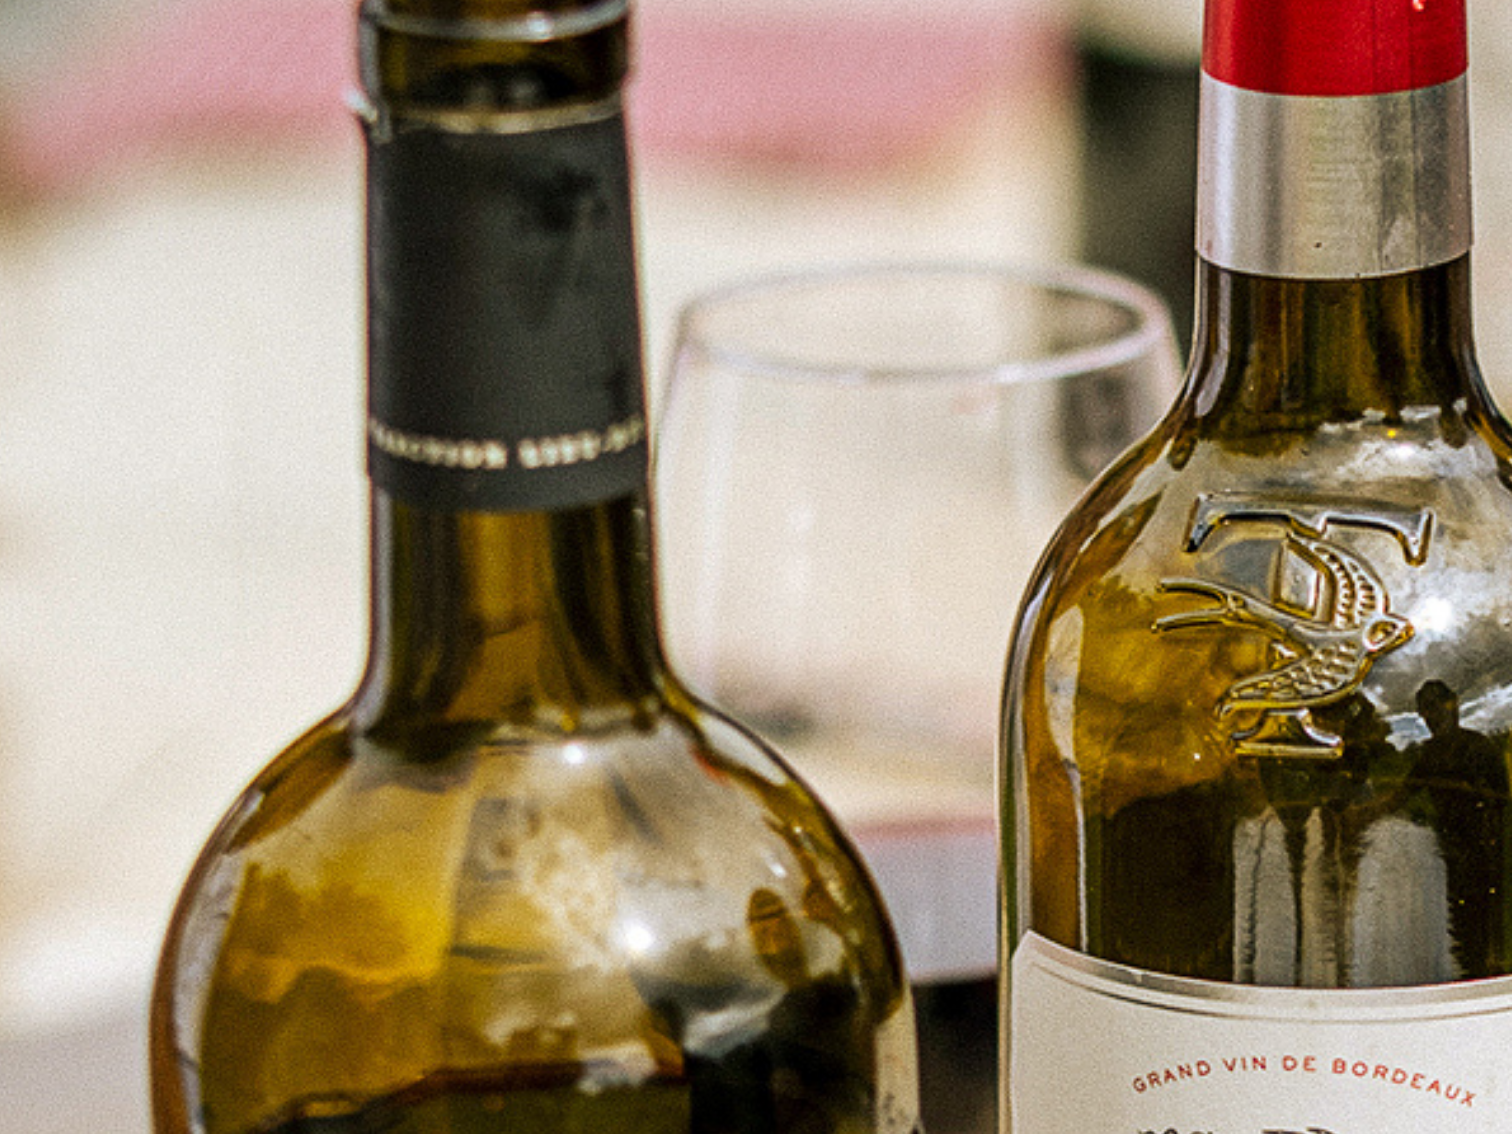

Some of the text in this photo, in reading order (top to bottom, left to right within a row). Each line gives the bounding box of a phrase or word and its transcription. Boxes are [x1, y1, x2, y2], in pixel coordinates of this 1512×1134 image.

[1132, 1054, 1476, 1107] GRAND VIN DE BORDEAUX
